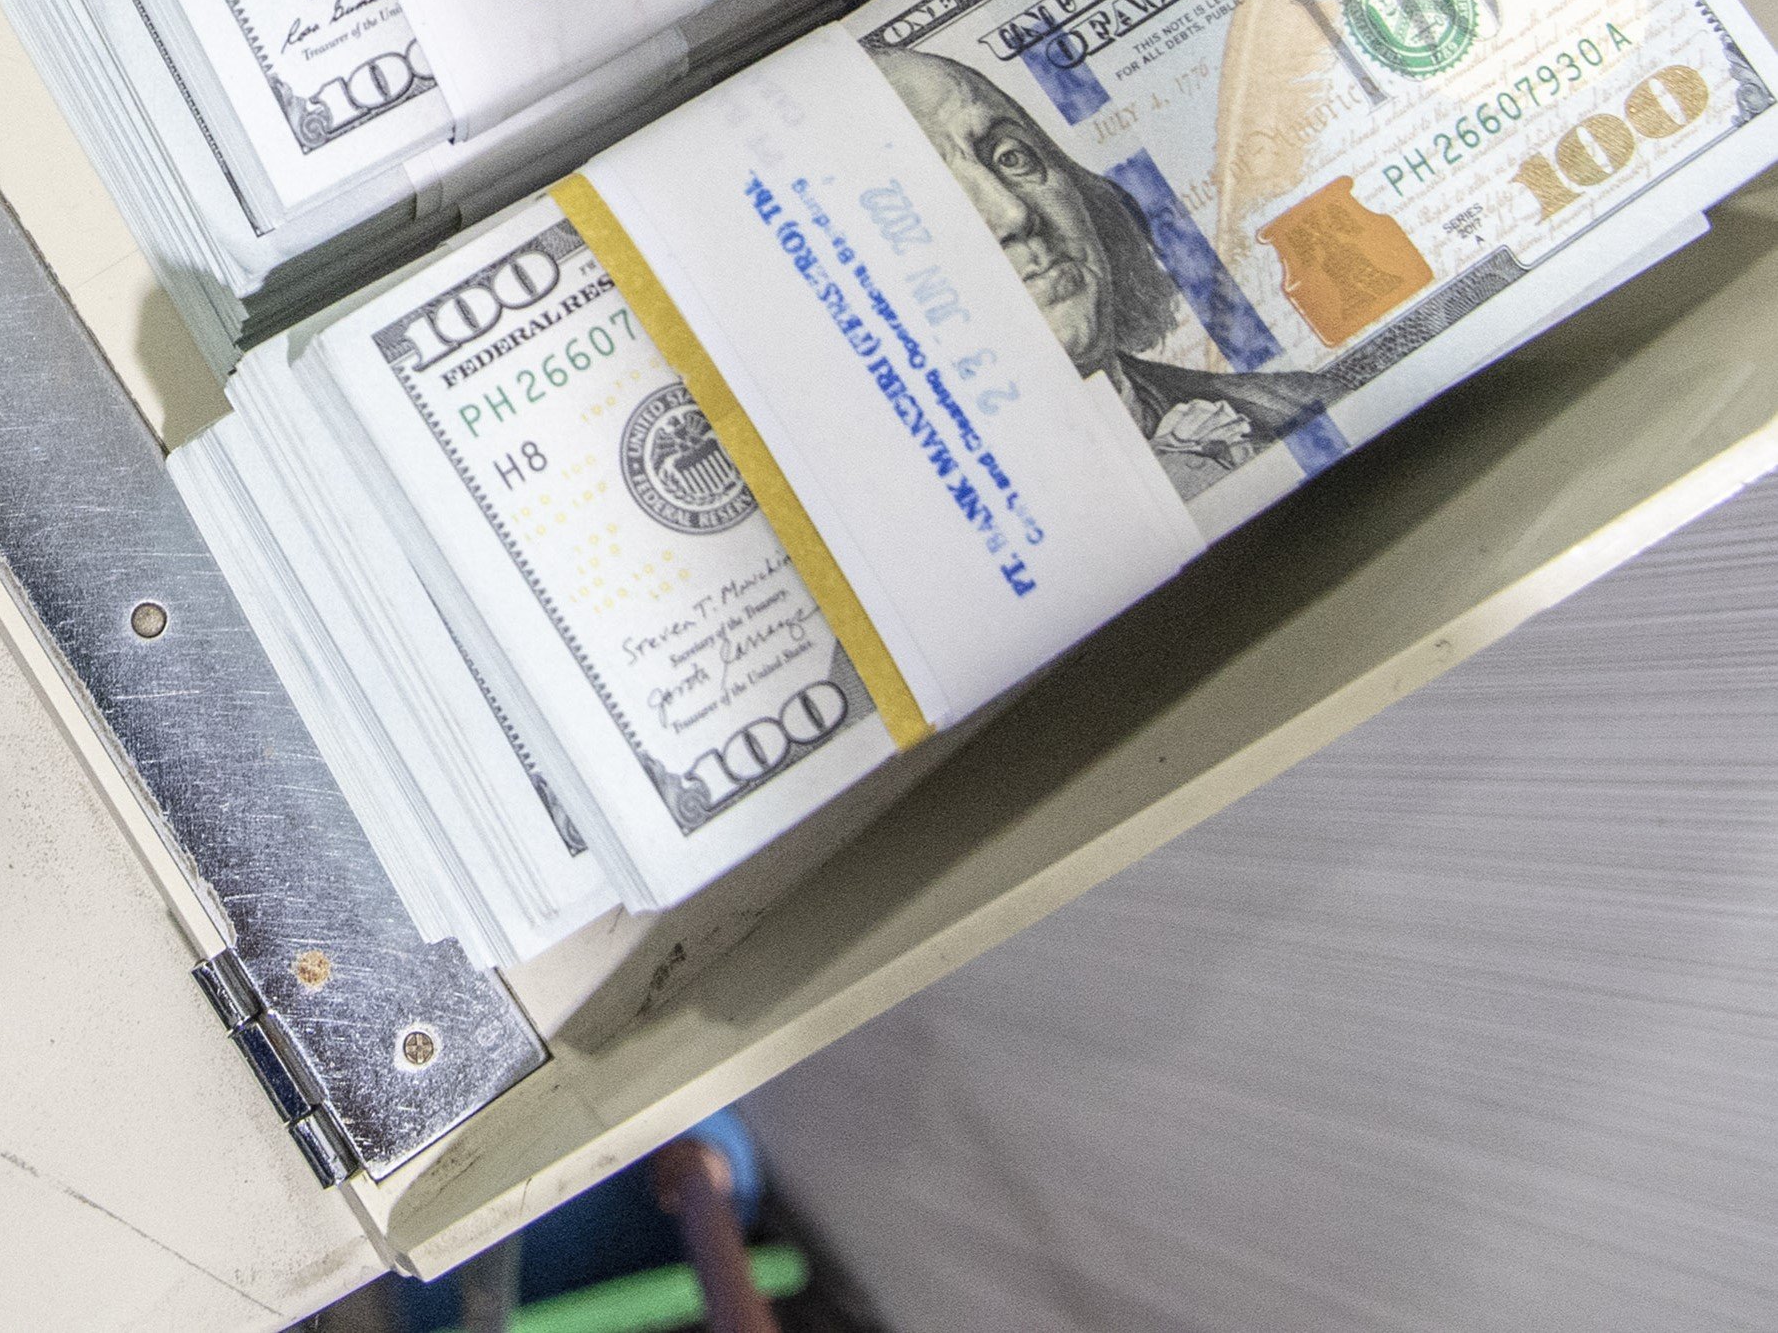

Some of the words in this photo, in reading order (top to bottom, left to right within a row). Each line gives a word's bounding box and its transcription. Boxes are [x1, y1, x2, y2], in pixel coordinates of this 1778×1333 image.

[301, 28, 350, 62] Treasurer
[1042, 9, 1120, 75] OF
[1132, 31, 1162, 55] THIS
[1161, 11, 1193, 37] NOTE
[1115, 60, 1140, 81] FOR
[1140, 44, 1166, 65] ALL
[1505, 54, 1715, 227] 100
[1442, 200, 1484, 235] SERIES
[1456, 216, 1484, 240] 2017
[393, 240, 567, 374] 100
[439, 304, 563, 390] FEDERAL
[493, 437, 549, 490] H8
[977, 450, 1011, 493] and
[682, 669, 855, 816] 100
